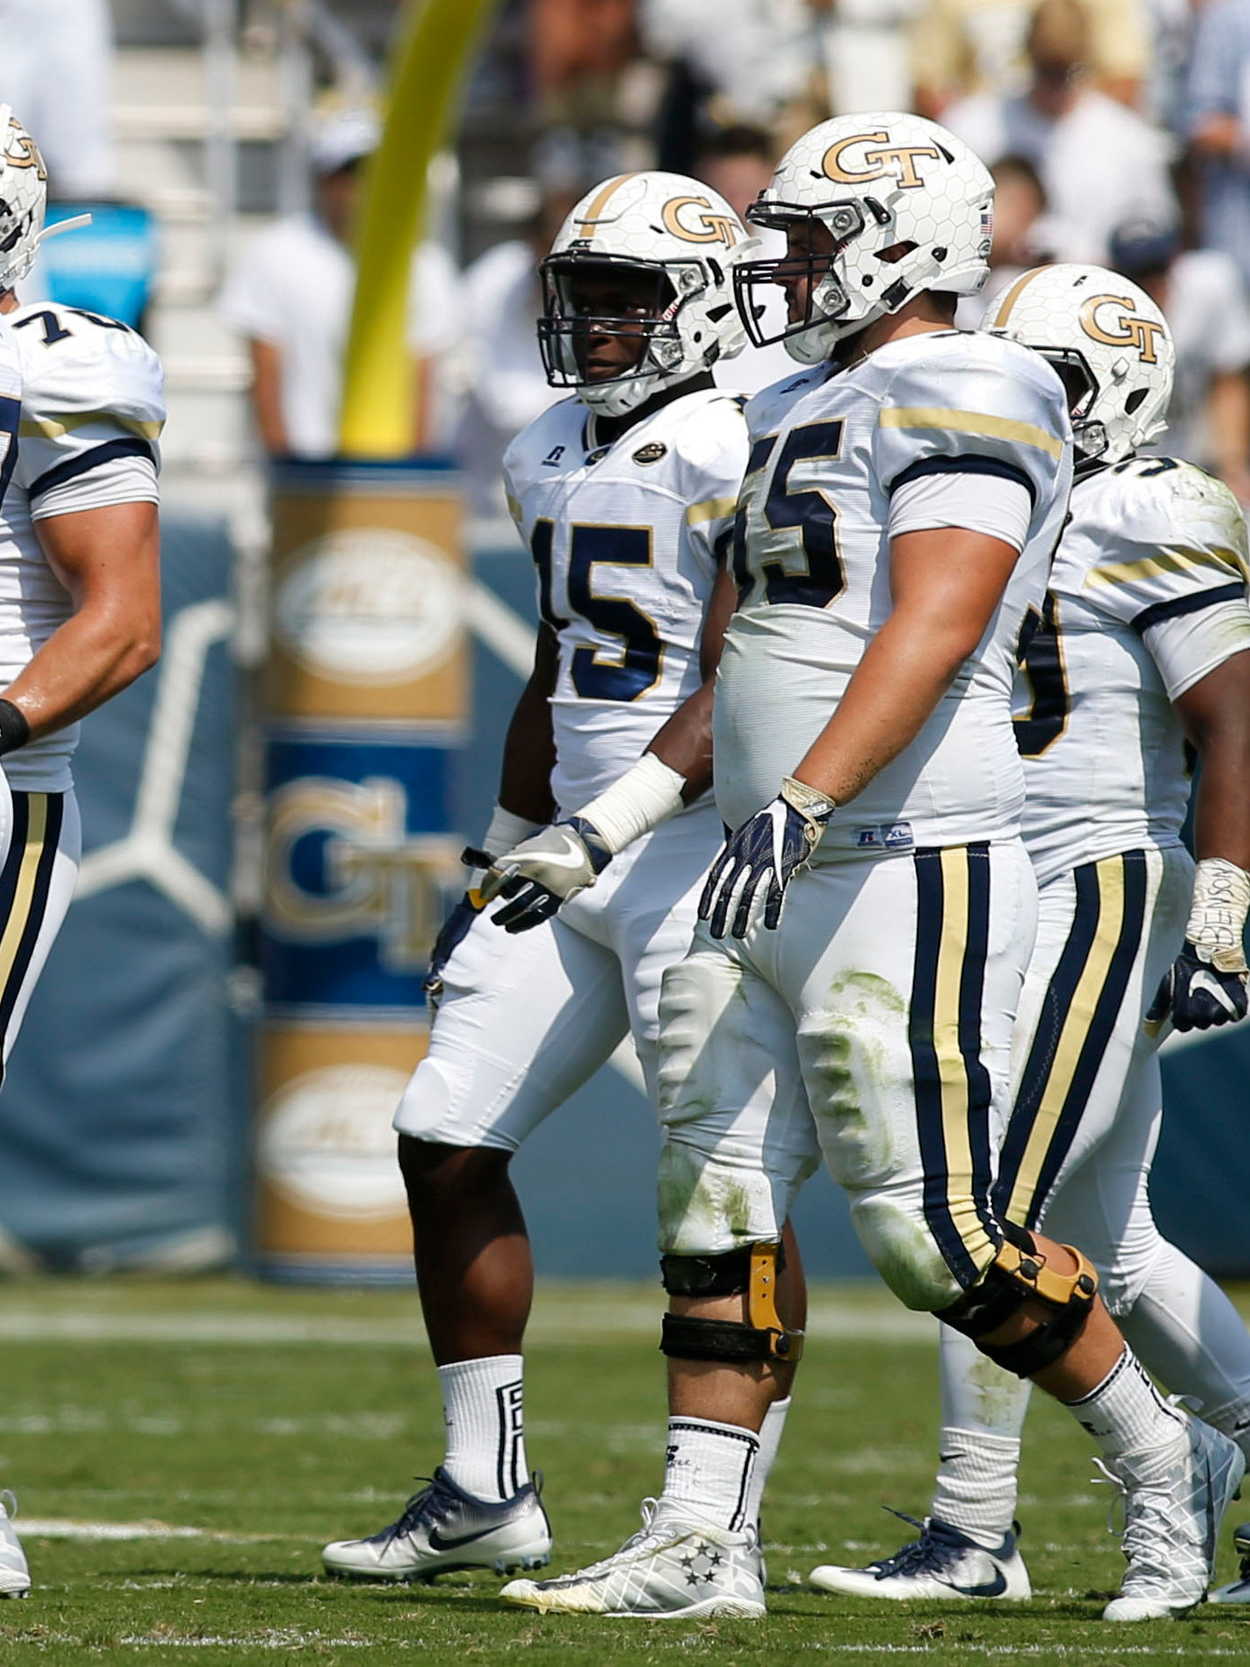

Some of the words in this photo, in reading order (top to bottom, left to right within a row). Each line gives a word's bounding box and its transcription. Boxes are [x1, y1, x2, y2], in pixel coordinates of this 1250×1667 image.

[822, 132, 939, 189] GT
[1079, 293, 1164, 363] GT
[531, 517, 667, 702] 15
[266, 775, 464, 972] GT
[1198, 869, 1234, 946] BENSON
